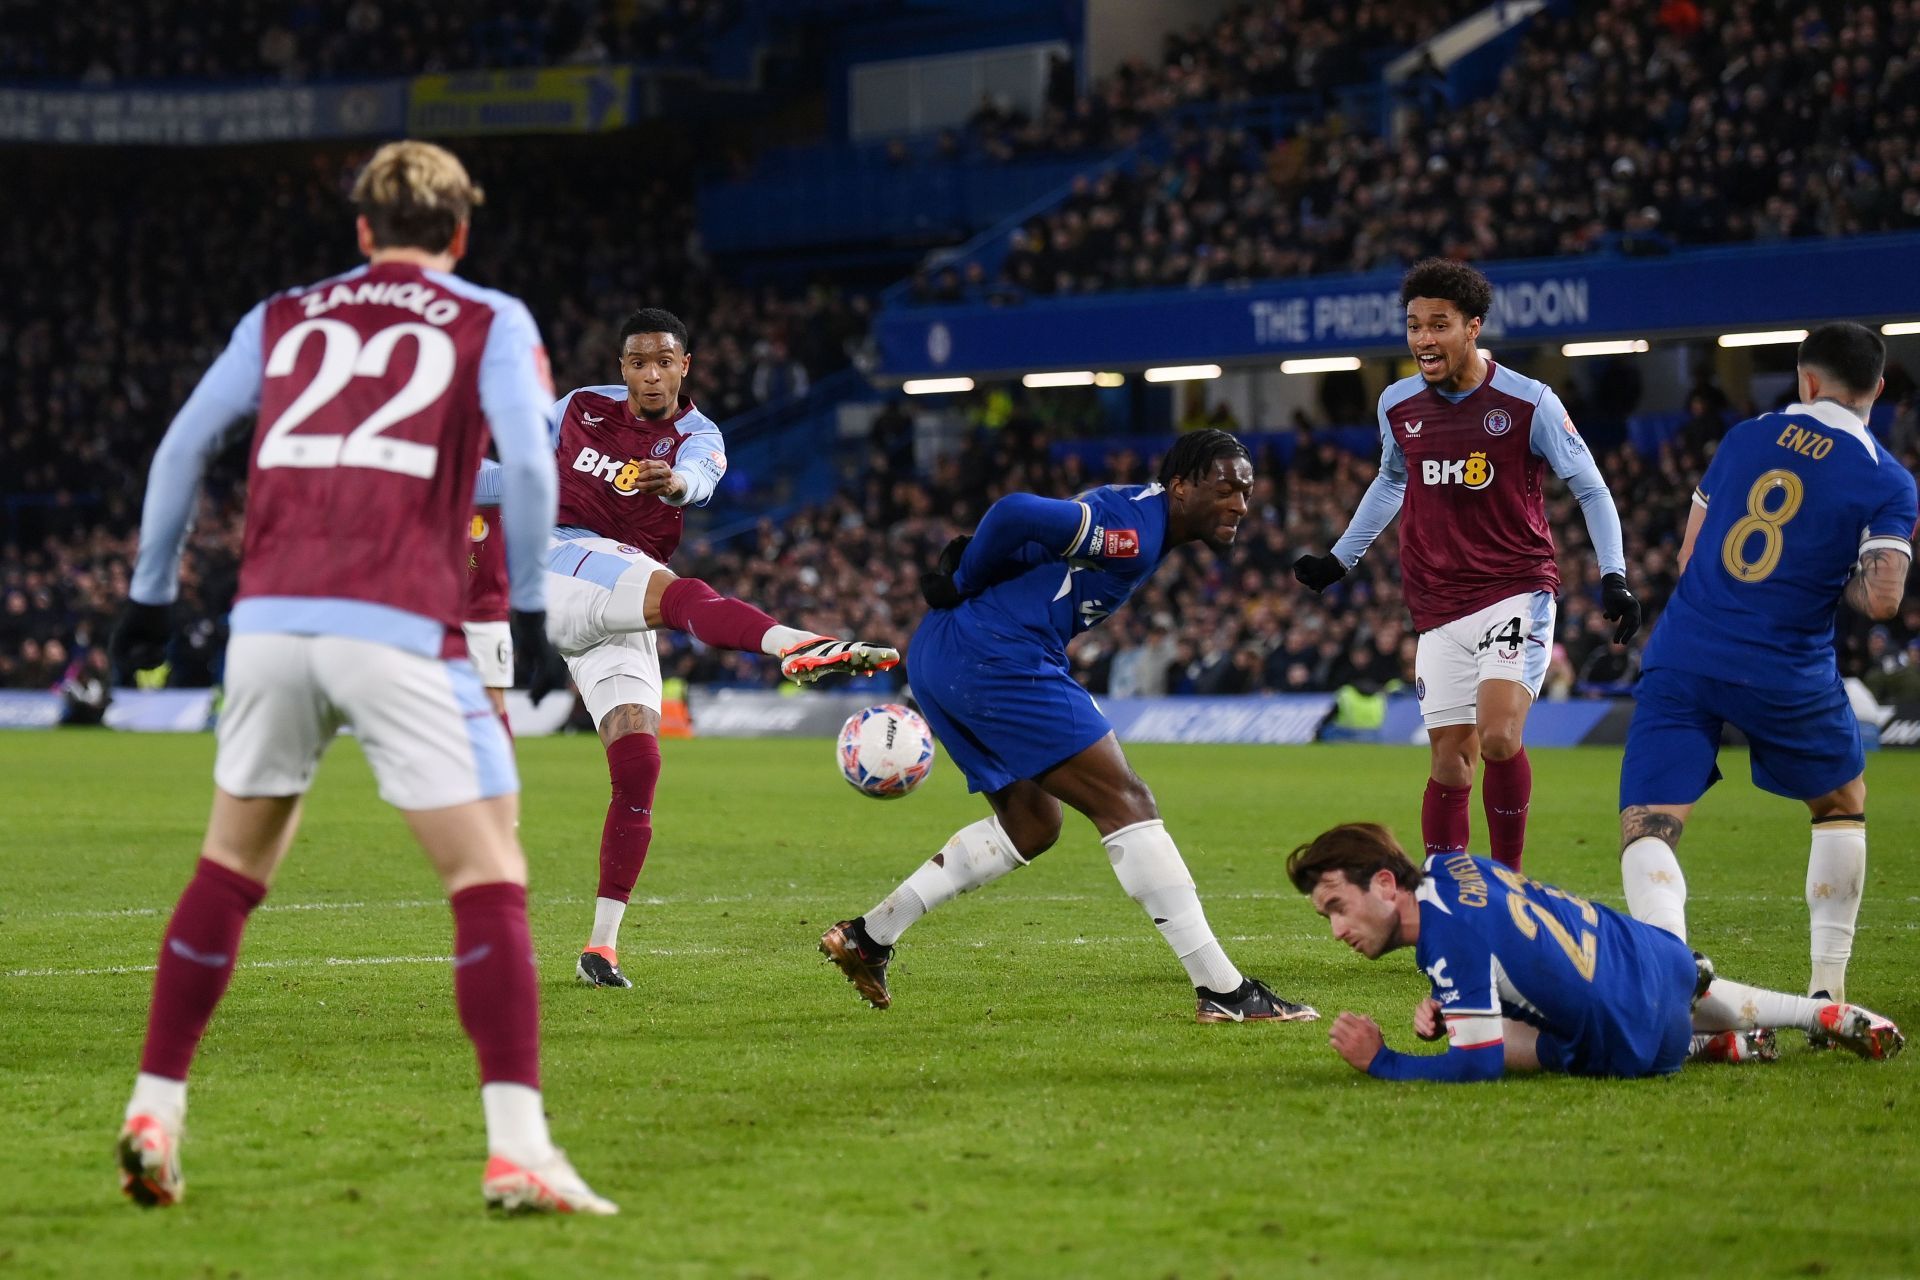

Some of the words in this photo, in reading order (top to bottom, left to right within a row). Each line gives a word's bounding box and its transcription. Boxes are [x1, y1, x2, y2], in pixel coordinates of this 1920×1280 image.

[300, 282, 460, 326] ZANIOLO
[1251, 300, 1311, 344] THE
[1314, 294, 1406, 340] PRIDE
[1492, 279, 1588, 328] NDON
[257, 318, 456, 480] 22
[1775, 424, 1834, 460] ENZO
[572, 446, 641, 492] BK8
[1422, 457, 1487, 486] BK8
[1721, 469, 1804, 583] 8
[1494, 803, 1530, 815] VILLA
